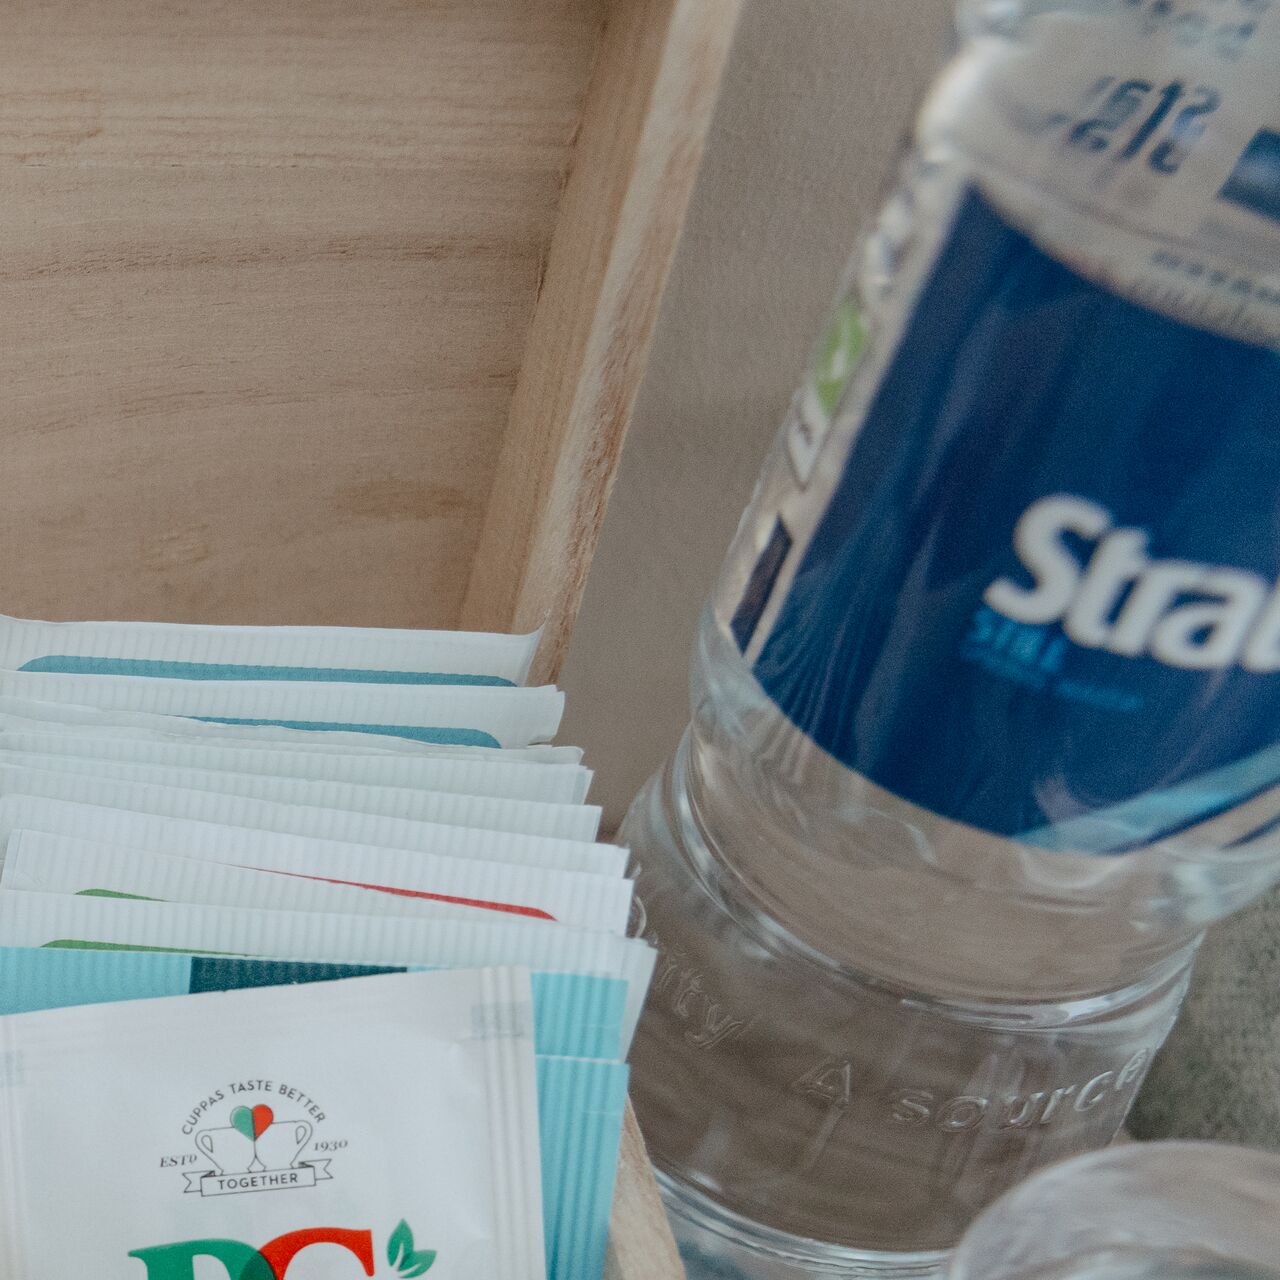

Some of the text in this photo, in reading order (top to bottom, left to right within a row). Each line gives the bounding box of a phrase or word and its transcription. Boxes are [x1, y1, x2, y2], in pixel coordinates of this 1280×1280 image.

[181, 1079, 326, 1137] CUPPAS TASTE BETTER
[312, 1138, 349, 1153] 1930
[217, 1172, 299, 1191] TOGETHER
